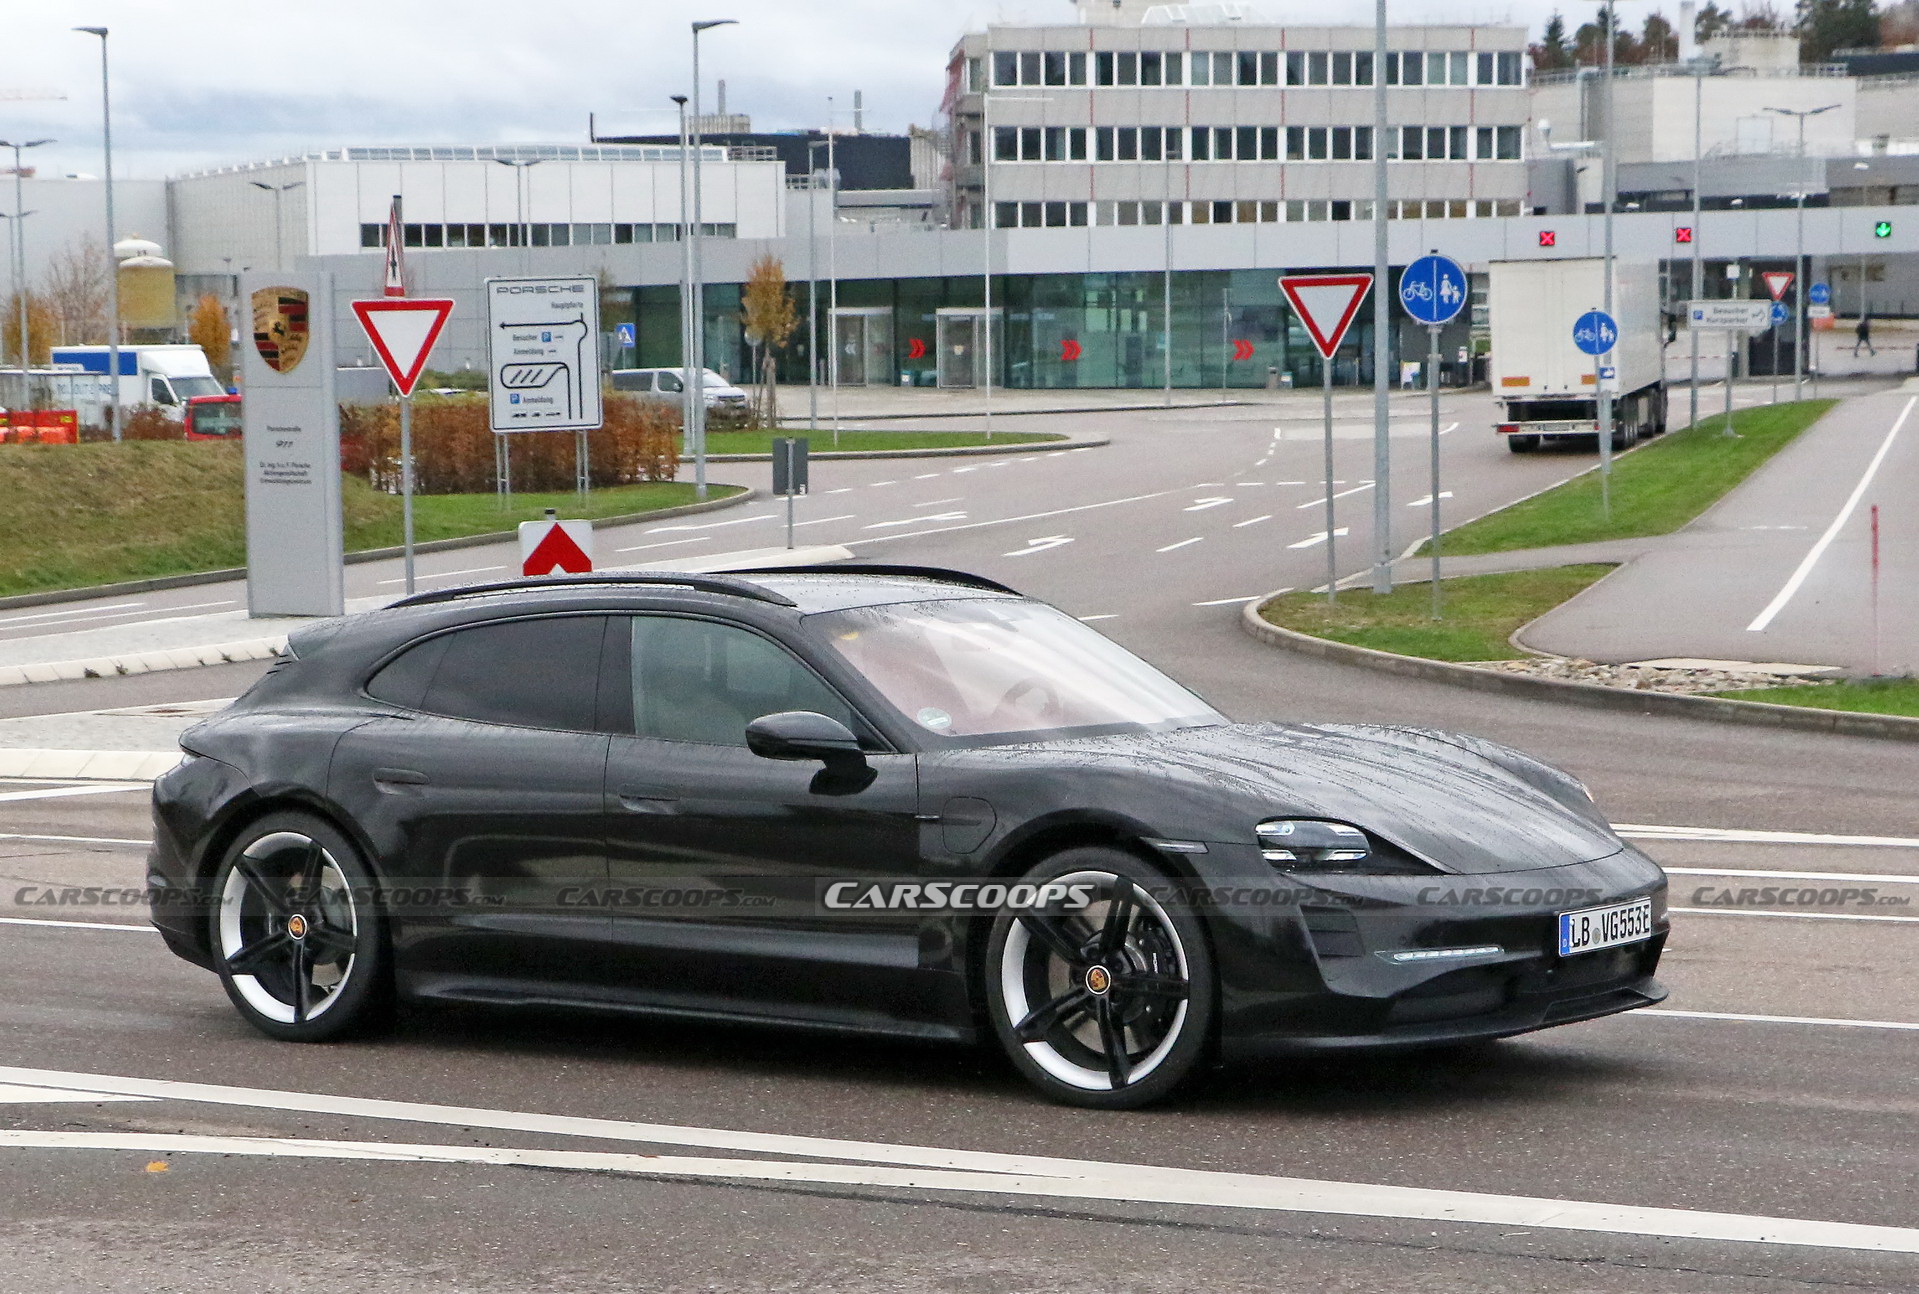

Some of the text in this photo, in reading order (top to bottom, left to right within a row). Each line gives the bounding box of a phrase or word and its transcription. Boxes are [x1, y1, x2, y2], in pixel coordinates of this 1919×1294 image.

[496, 284, 584, 294] PORSCHE
[1571, 916, 1590, 947] LB
[1602, 905, 1650, 942] VG553E
